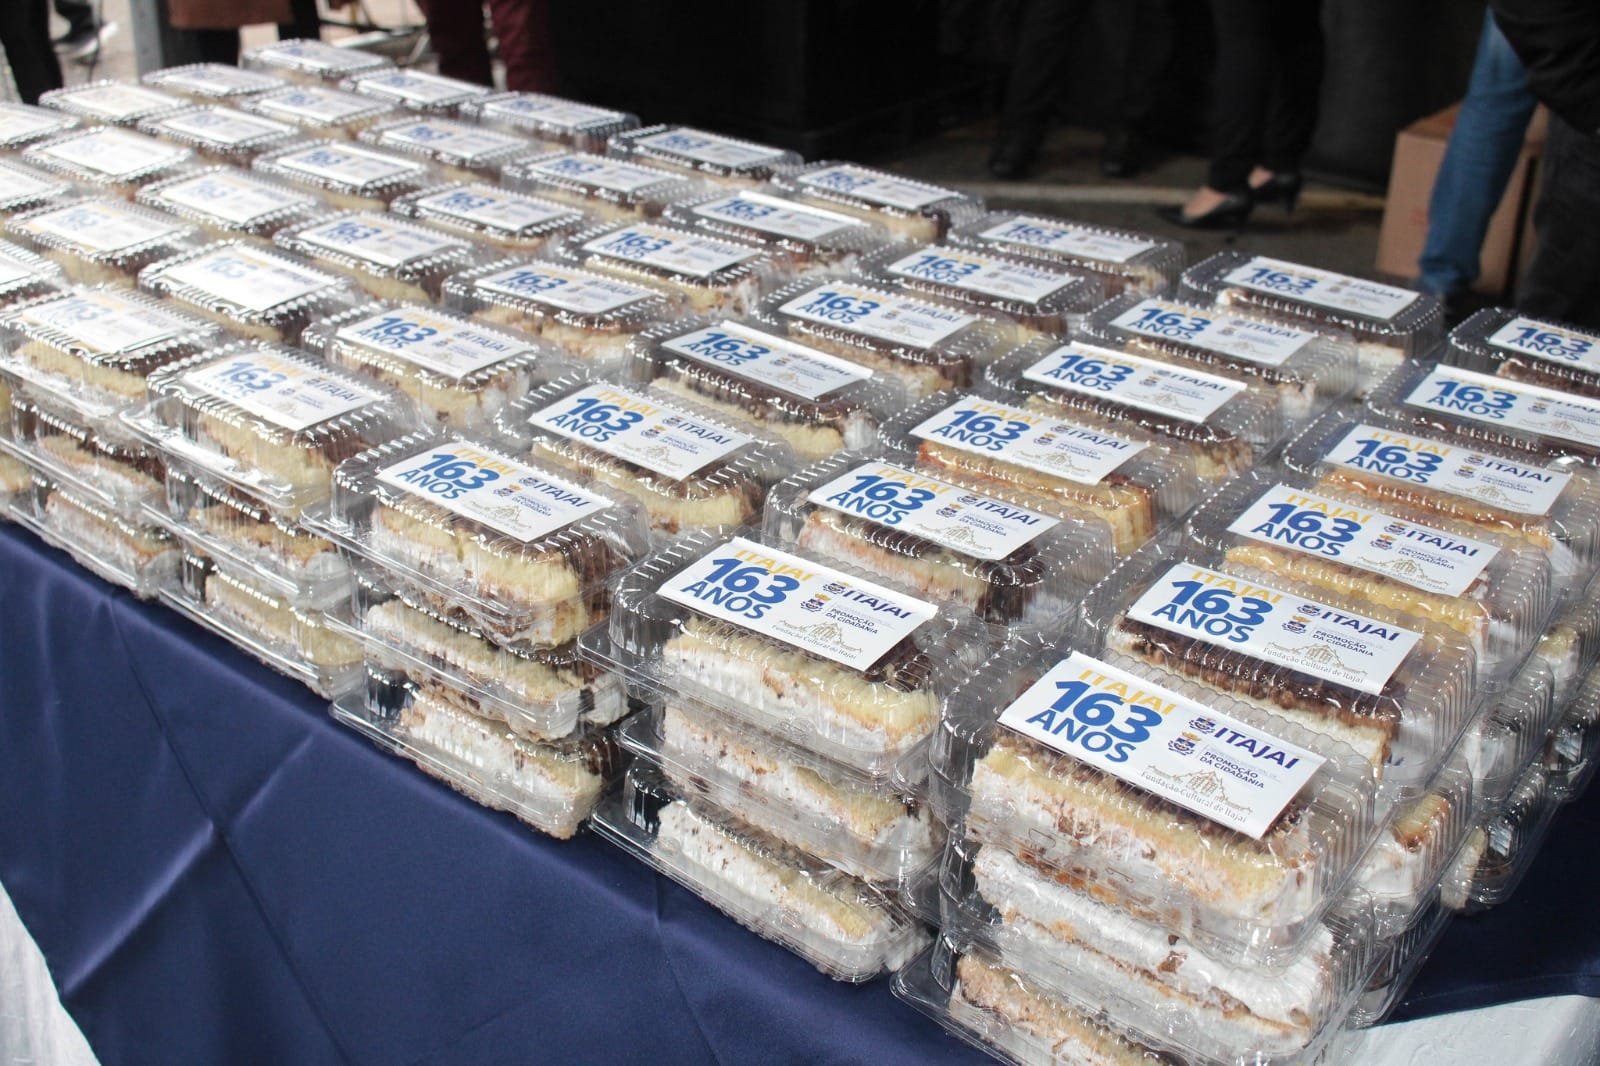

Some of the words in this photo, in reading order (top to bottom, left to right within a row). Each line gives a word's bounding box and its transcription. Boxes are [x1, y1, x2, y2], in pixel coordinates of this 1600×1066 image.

[612, 232, 673, 251] 163
[916, 255, 981, 275] 163
[1251, 267, 1319, 289] 163
[505, 271, 569, 289] 163
[1239, 276, 1306, 295] ANOS
[795, 303, 860, 323] ANOS
[811, 291, 880, 315] 163
[370, 317, 438, 342] 163
[1125, 320, 1197, 339] ANOS
[1139, 308, 1212, 331] 163
[679, 342, 747, 366] ANOS
[698, 332, 770, 359] 163
[1507, 337, 1583, 361] ANOS
[1517, 327, 1594, 353] 163
[217, 362, 287, 390] 163
[1042, 367, 1117, 391] ANOS
[1057, 354, 1134, 382] 163
[1426, 395, 1507, 420] ANOS
[1436, 380, 1517, 409] 163
[545, 413, 616, 442] ANOS
[566, 398, 644, 431] 163
[948, 409, 1030, 440] 163
[929, 425, 1009, 450] ANOS
[1343, 455, 1430, 483] ANOS
[1355, 439, 1443, 472] 163
[394, 469, 467, 499] ANOS
[418, 454, 500, 489] 163
[847, 474, 935, 510] 163
[825, 491, 909, 522] ANOS
[1268, 503, 1361, 542] 163
[1250, 522, 1344, 555] ANOS
[703, 558, 800, 603] 163
[679, 580, 771, 619] ANOS
[1171, 580, 1273, 625] 163
[822, 611, 838, 619] DA
[833, 615, 880, 635] CIDADANIA
[827, 608, 875, 628] PROMOÇÃO
[1152, 603, 1253, 641] ANOS
[1310, 633, 1325, 641] DA
[1323, 637, 1376, 657] CIDADANIA
[1314, 630, 1367, 650] PROMOÇÃO
[1298, 658, 1332, 673] Cultural
[1050, 681, 1162, 742] 163
[1026, 709, 1135, 762] ANOS
[1197, 756, 1214, 767] DA
[1210, 762, 1267, 790] CIDADANIA
[1201, 751, 1259, 780] PROMOÇÃO
[1137, 770, 1180, 793] Fundação
[1177, 788, 1214, 808] Cultural
